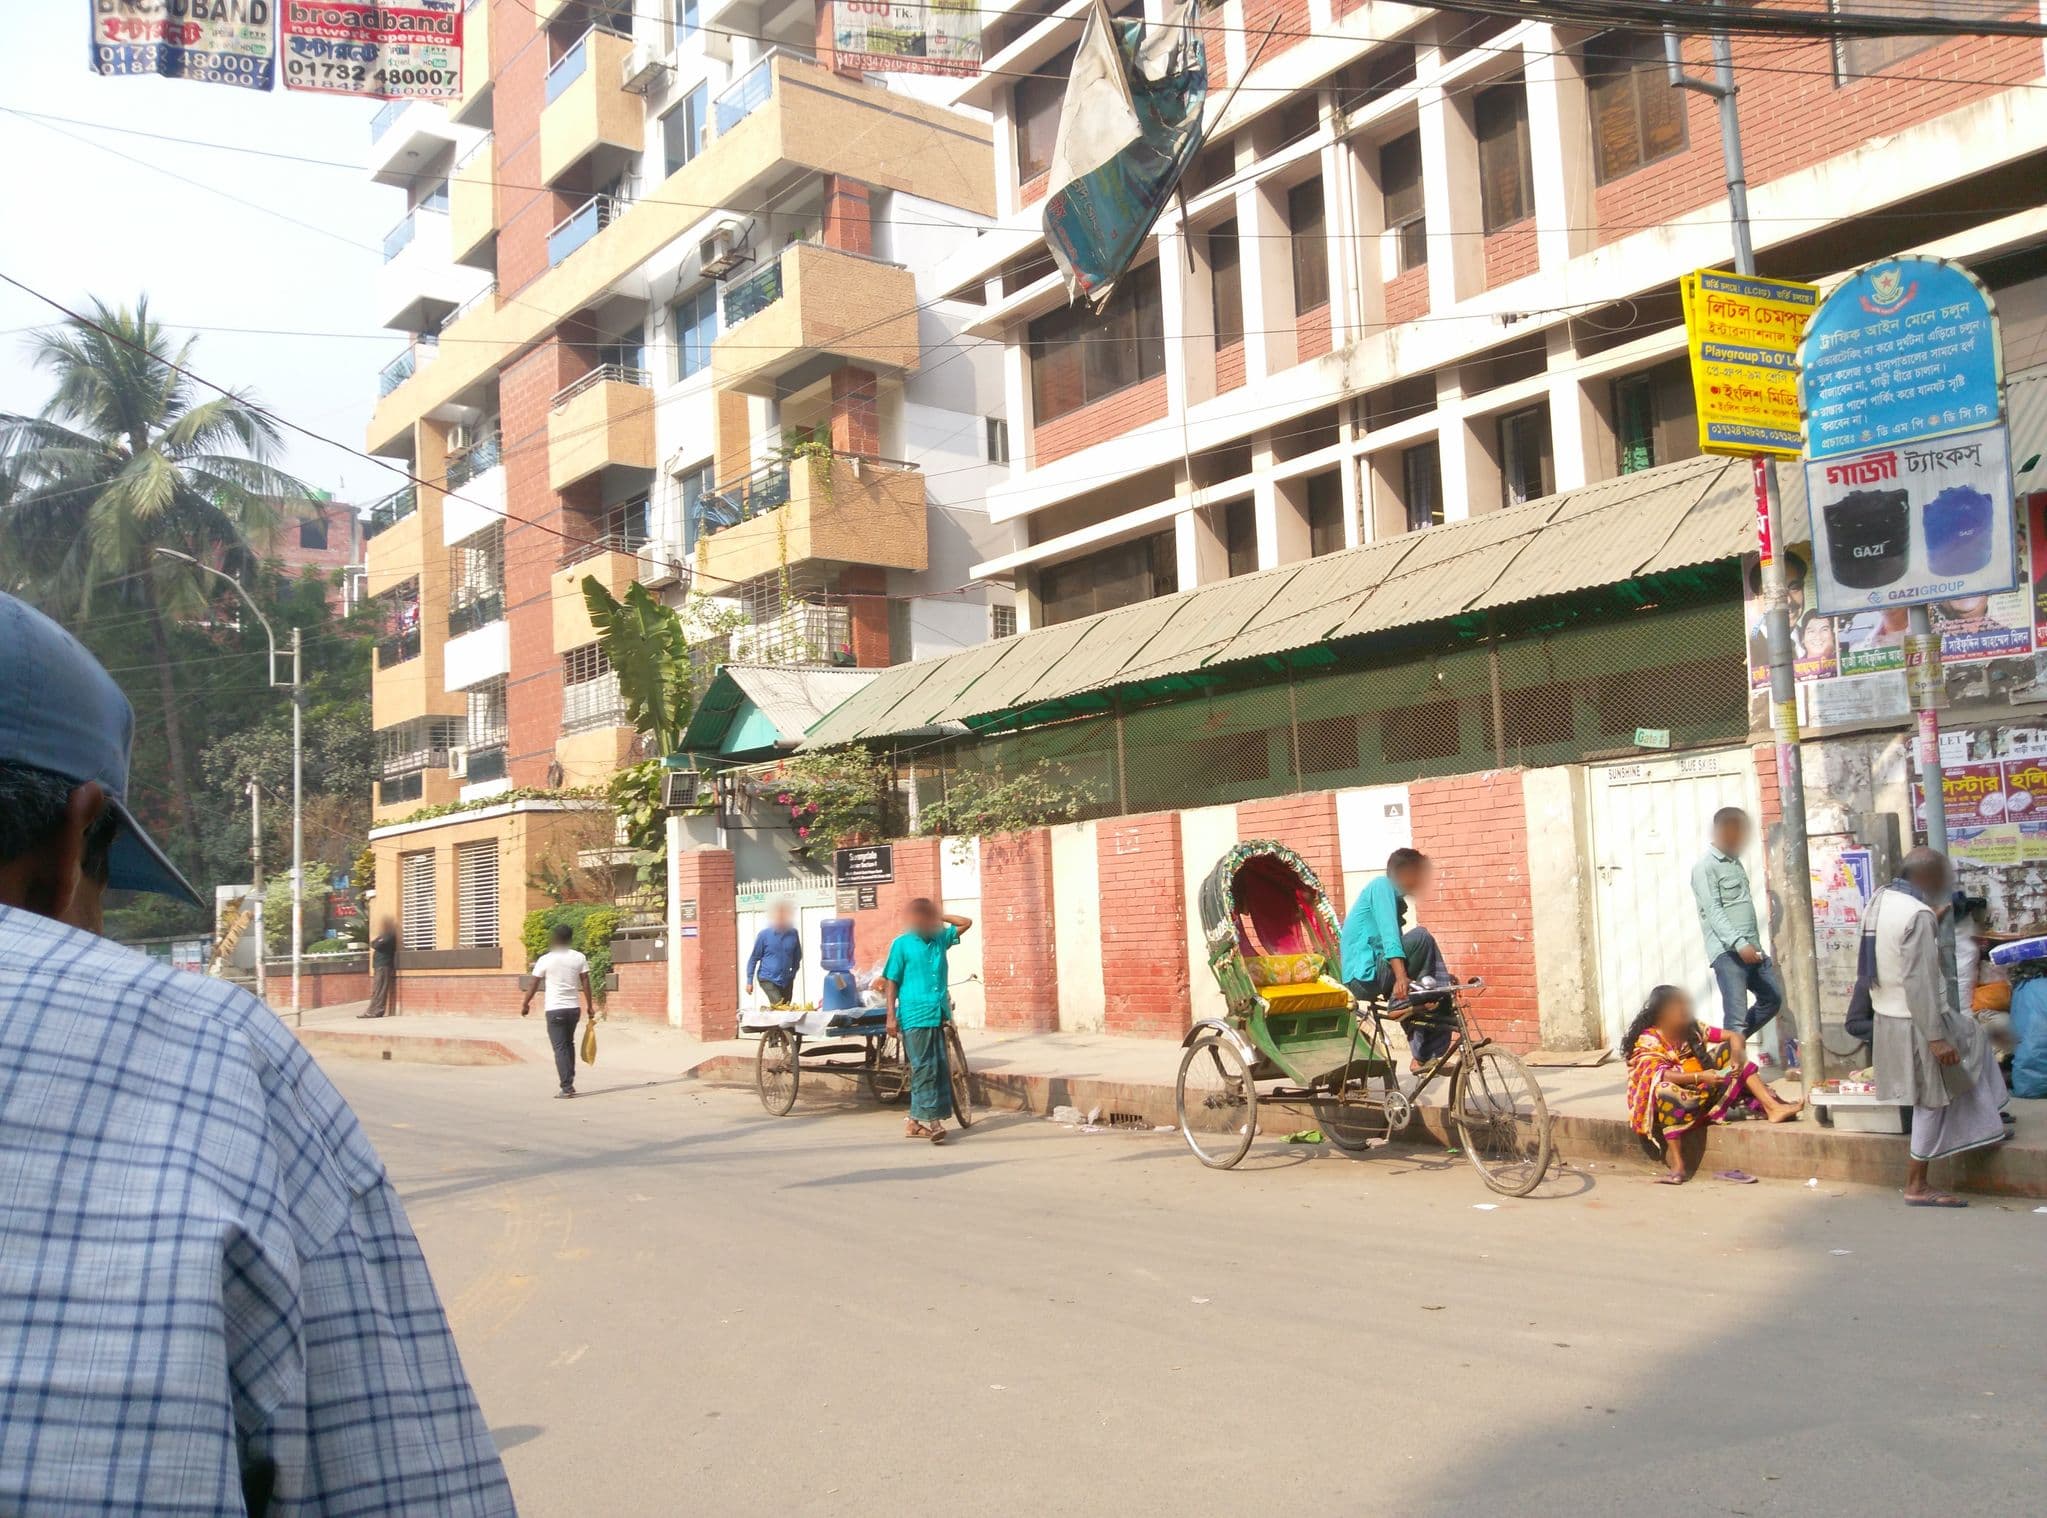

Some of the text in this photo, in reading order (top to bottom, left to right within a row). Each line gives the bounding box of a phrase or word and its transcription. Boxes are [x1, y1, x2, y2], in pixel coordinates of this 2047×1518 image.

[290, 2, 455, 34] broadband
[291, 25, 454, 45] network operator
[288, 36, 380, 63] ইন্টারনেট
[177, 52, 269, 74] 480007
[288, 60, 458, 86] 01732 480007
[289, 77, 457, 96] 01842 480007
[1707, 294, 1751, 321] লিটল
[1819, 301, 1970, 351] ট্রাফিক আইন মেনে চলুন
[1705, 345, 1759, 364] Playgroup
[1761, 352, 1771, 364] To
[1864, 344, 1873, 355] না
[1876, 340, 1894, 353] করে
[1864, 364, 1873, 374] ও
[1722, 384, 1763, 403] ইংলিশ
[1875, 424, 1889, 438] ডি
[1892, 421, 1909, 434] এম
[1911, 416, 1924, 430] পি
[1943, 410, 1956, 425] ডি
[1959, 406, 1972, 420] সি
[1975, 403, 1988, 417] সি
[1825, 444, 1983, 487] গাজী ট্যাংকস্
[1853, 544, 1886, 558] GAZI
[1637, 730, 1657, 744] Gate
[1940, 735, 1962, 747] LET
[1608, 758, 1717, 780] SUNSHINE BLUE SKIES
